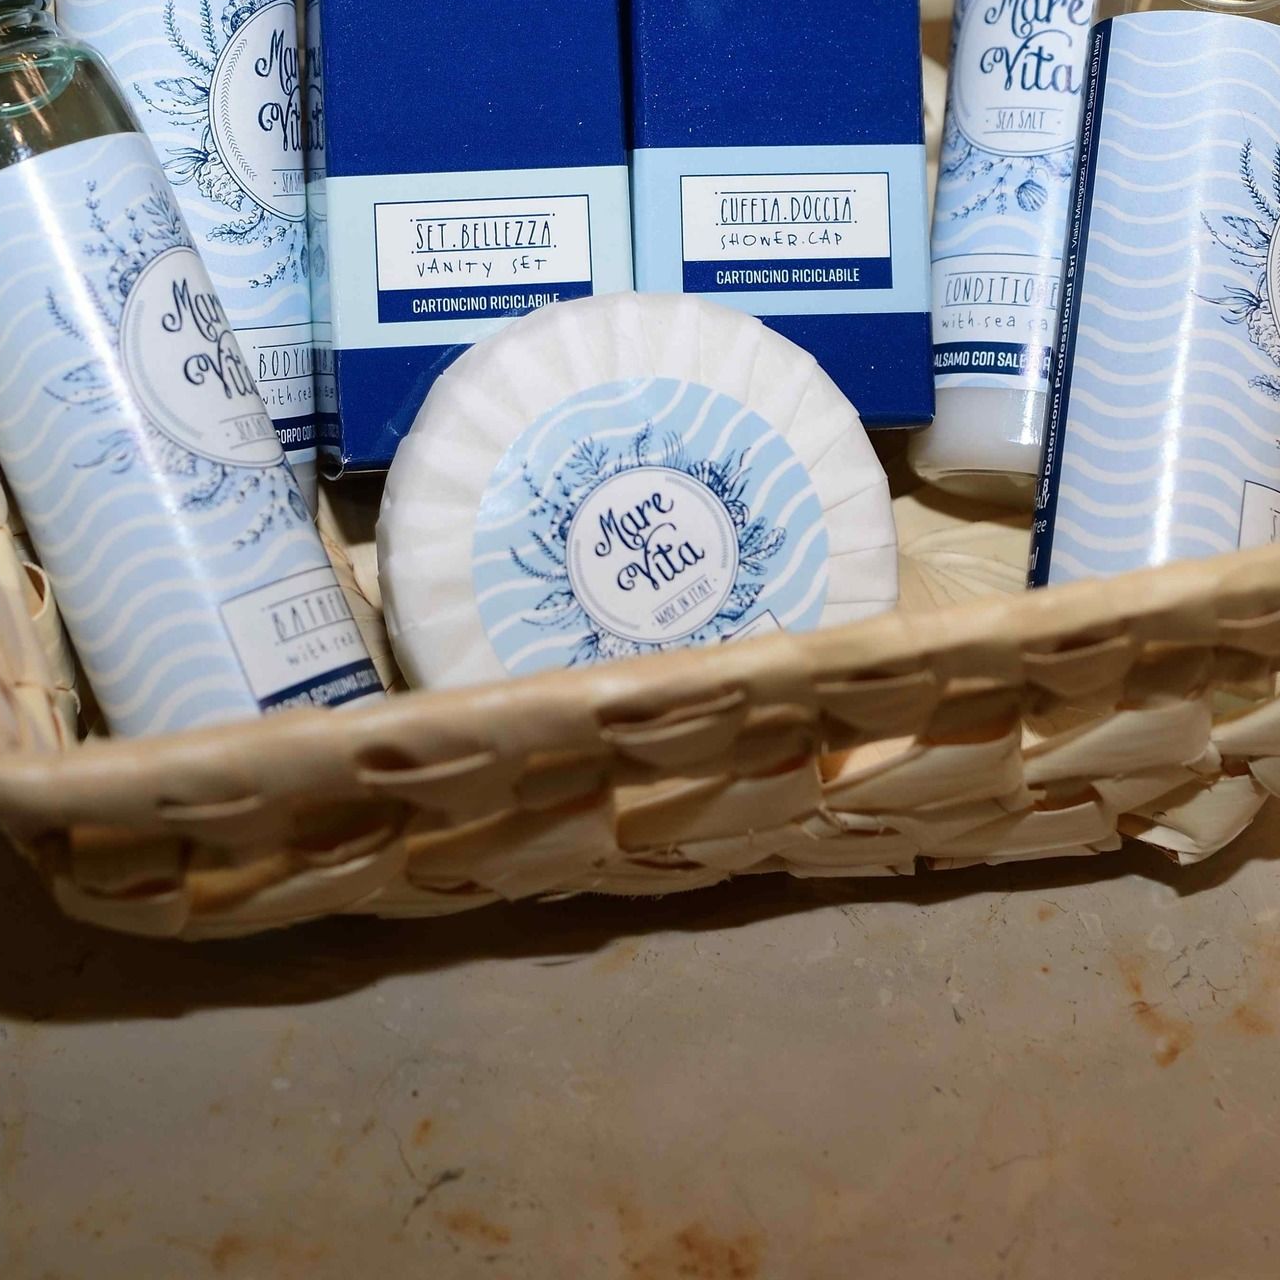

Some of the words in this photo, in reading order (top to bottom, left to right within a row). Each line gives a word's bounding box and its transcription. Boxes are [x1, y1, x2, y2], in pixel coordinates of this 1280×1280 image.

[1093, 33, 1102, 56] Italy
[979, 28, 1082, 96] Vita
[1087, 78, 1096, 110] Siena
[995, 109, 1014, 130] SEA
[1019, 109, 1046, 130] SALT
[1083, 111, 1092, 145] 53100
[1071, 221, 1080, 249] Viale
[416, 257, 494, 278] VANITY
[511, 255, 548, 275] SET
[716, 268, 790, 285] CARTONCINO
[791, 267, 861, 284] RICICLABILE
[1067, 254, 1076, 278] Srl
[411, 296, 488, 315] CARTONCINO
[1054, 282, 1073, 388] Professional
[933, 351, 970, 368] ALSAMO
[594, 492, 675, 558] Mare
[616, 521, 706, 591] Vita
